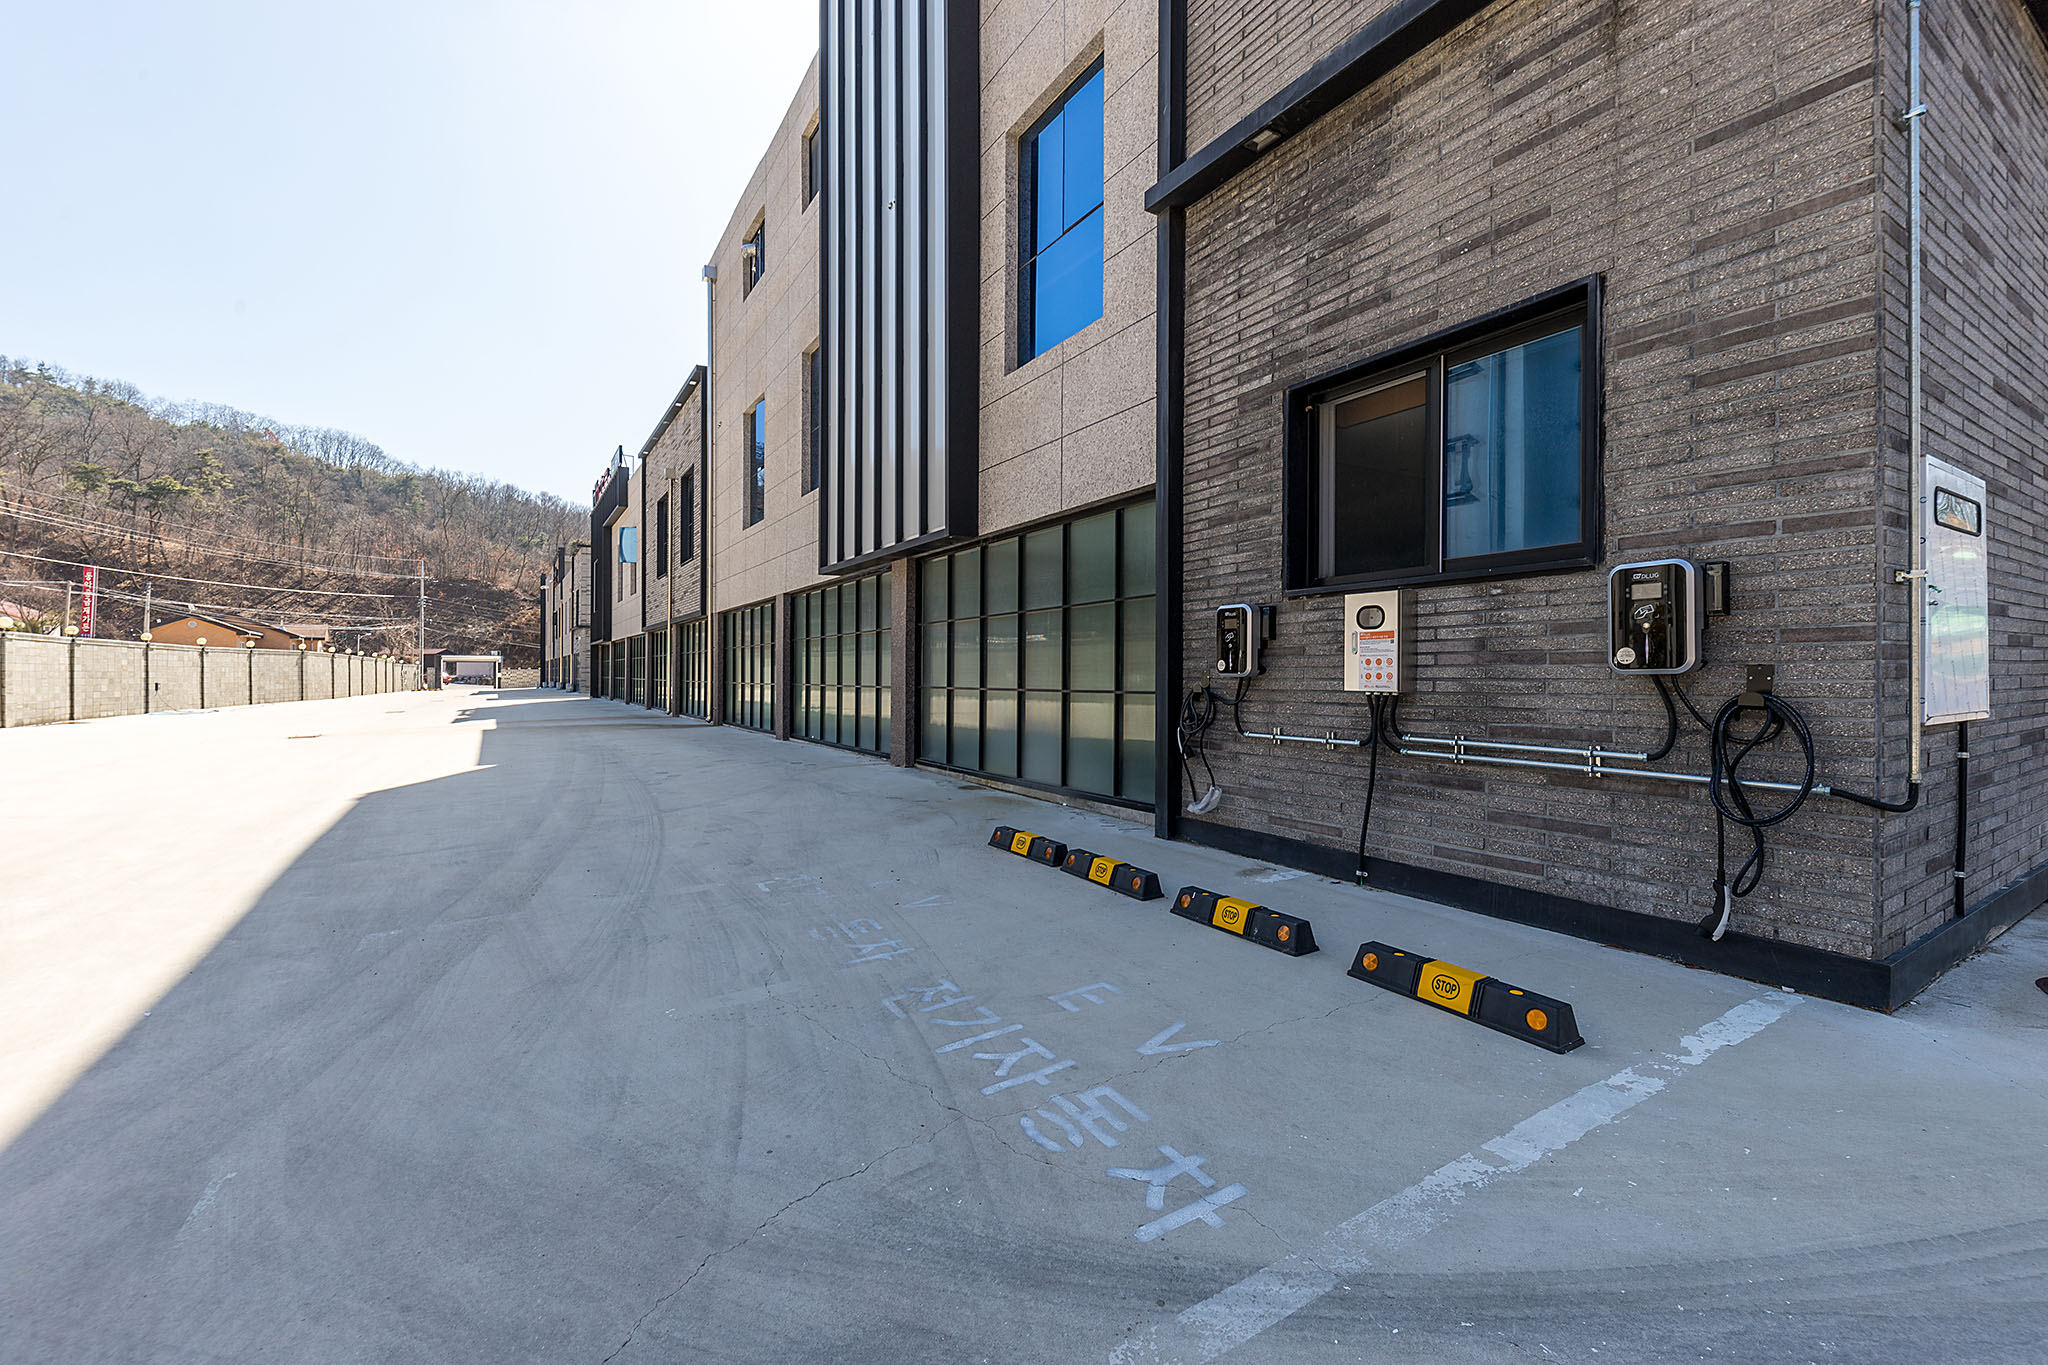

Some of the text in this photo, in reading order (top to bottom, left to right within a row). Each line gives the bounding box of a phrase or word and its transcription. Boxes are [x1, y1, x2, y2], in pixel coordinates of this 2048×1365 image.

[1223, 908, 1238, 922] STOP
[1434, 978, 1457, 996] STOP
[882, 978, 1250, 1243] 전기자동차
